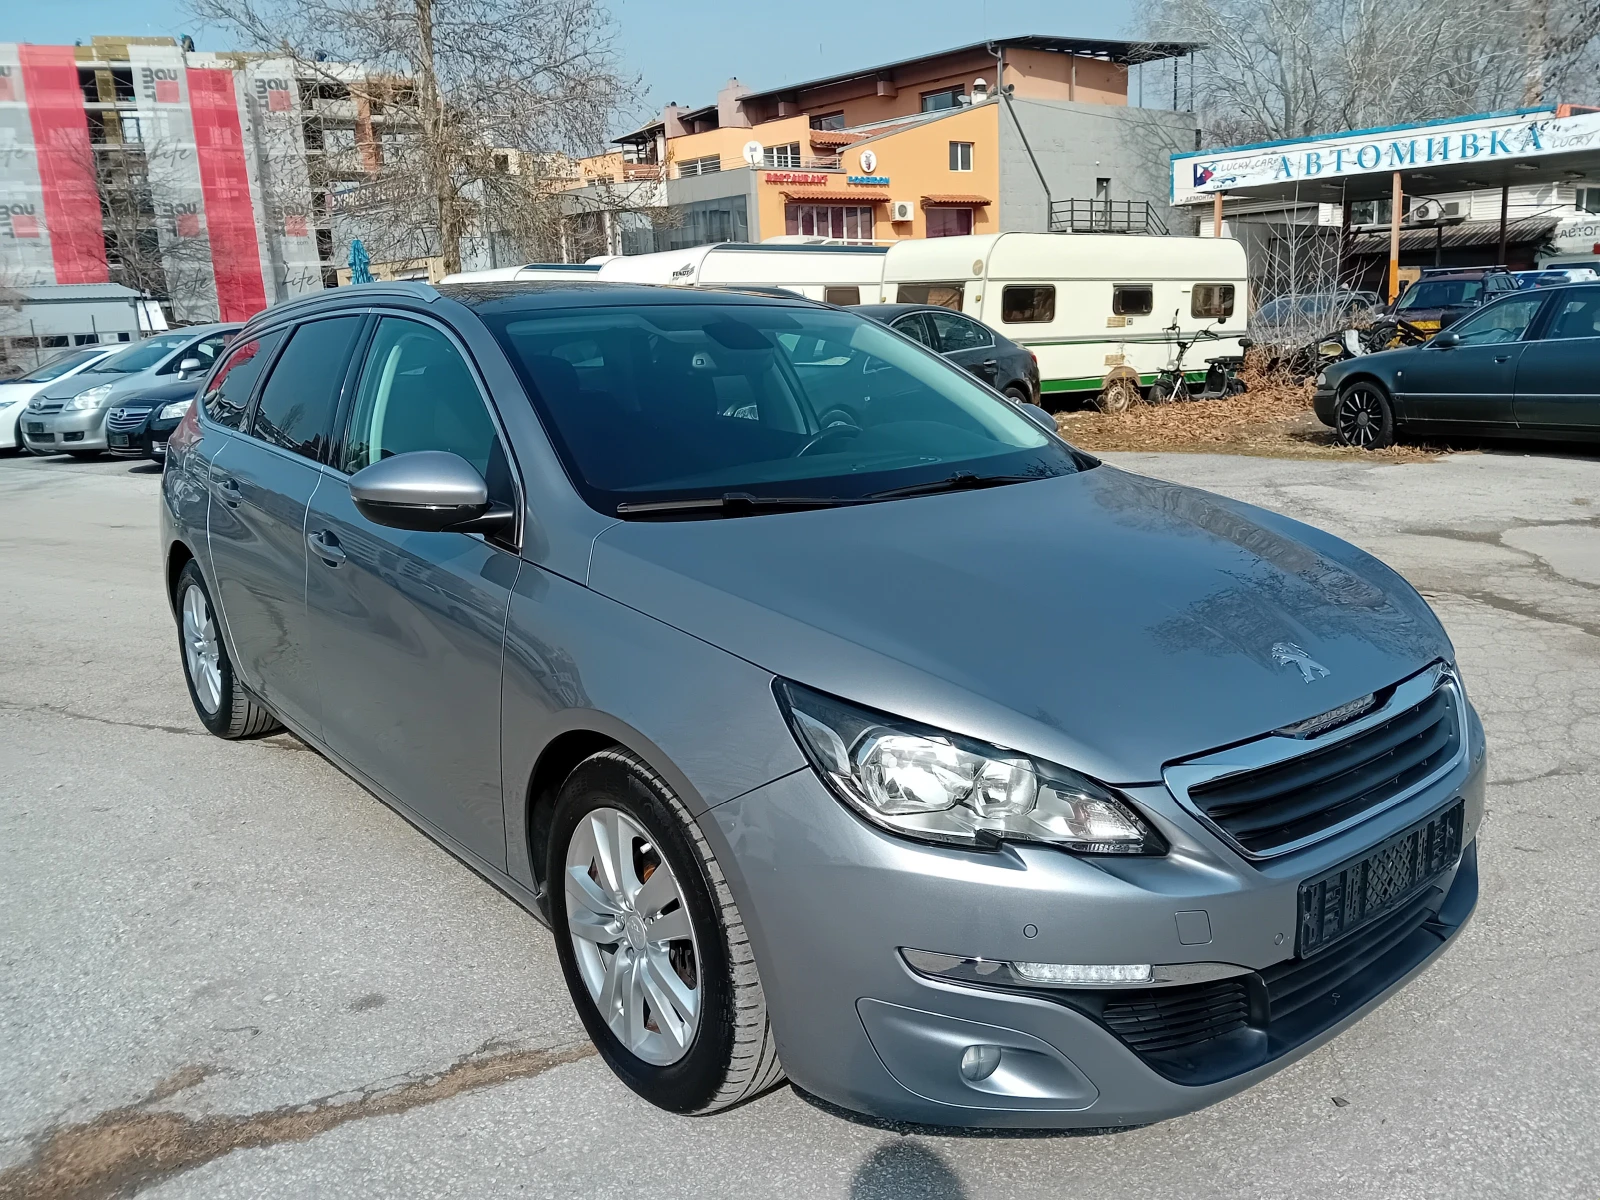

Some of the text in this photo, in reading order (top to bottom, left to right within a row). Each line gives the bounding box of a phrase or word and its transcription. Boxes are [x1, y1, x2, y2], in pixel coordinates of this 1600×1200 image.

[1274, 121, 1542, 179] АВТОМИВКА
[1552, 134, 1594, 148] LUCKY
[1220, 160, 1251, 172] LUCKY
[1185, 193, 1215, 203] ДЕМОНТА
[282, 265, 319, 293] Life
[1308, 698, 1366, 724] PEUGEOT
